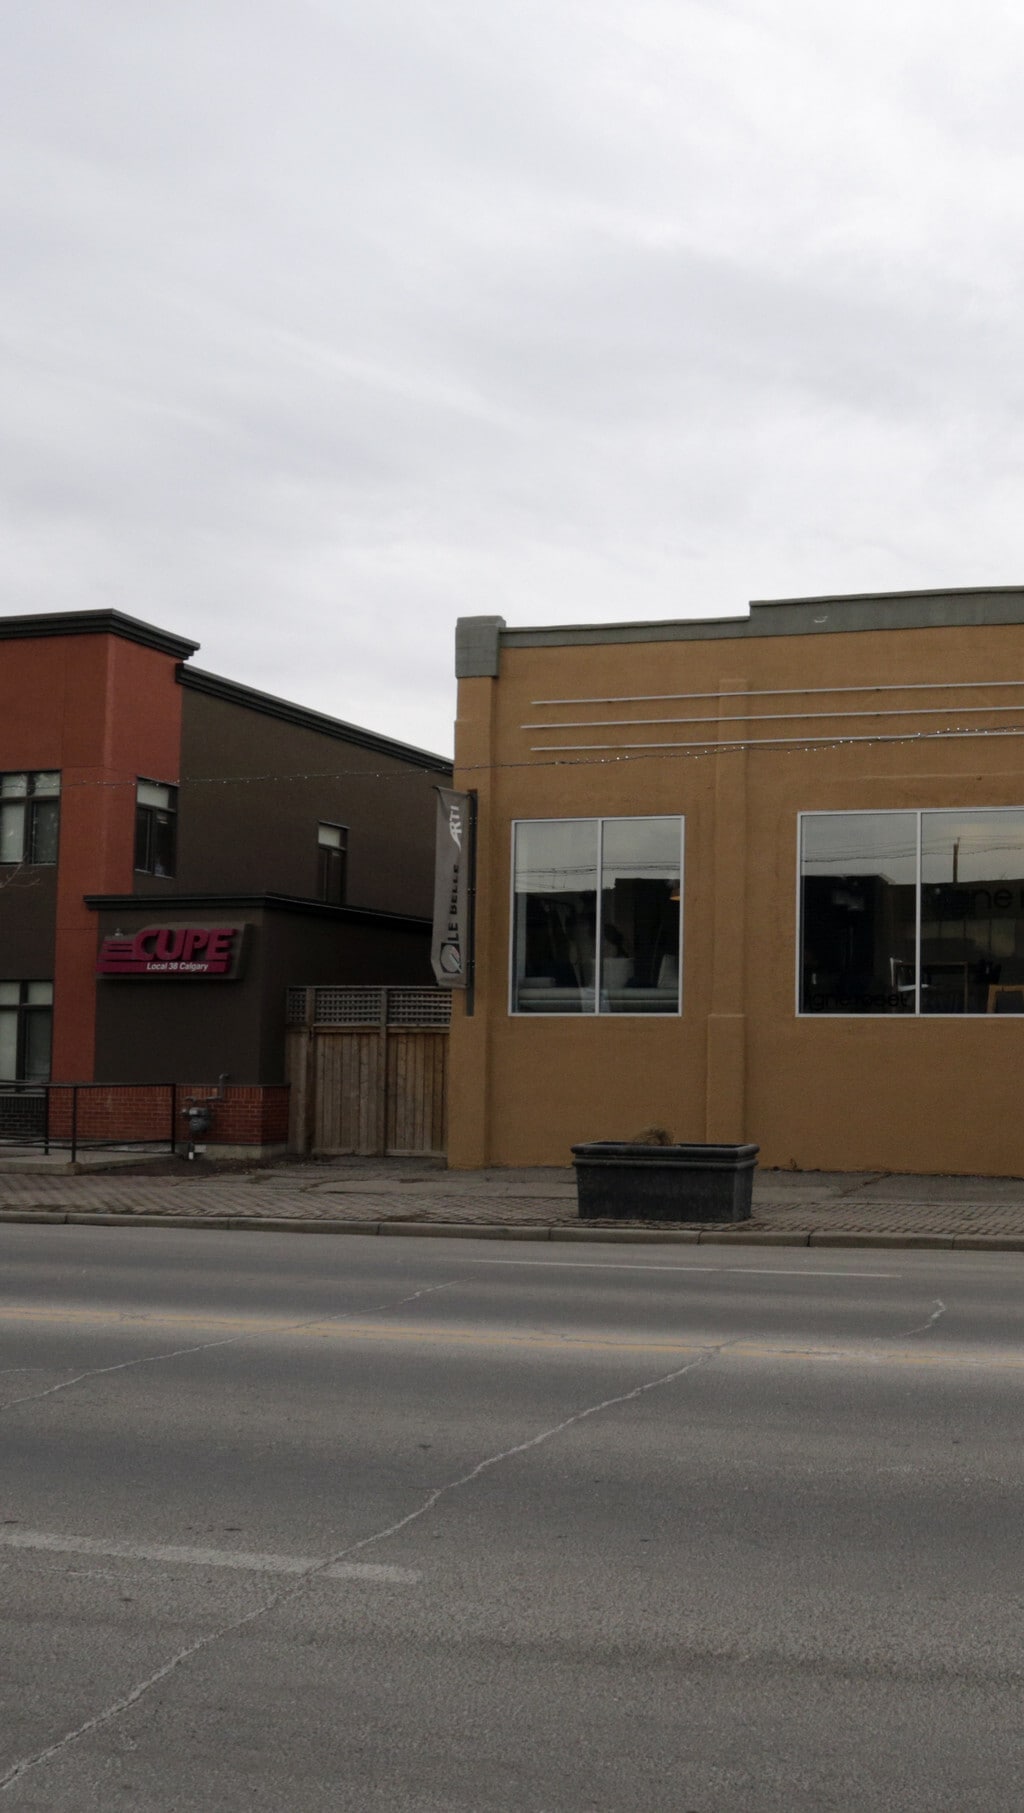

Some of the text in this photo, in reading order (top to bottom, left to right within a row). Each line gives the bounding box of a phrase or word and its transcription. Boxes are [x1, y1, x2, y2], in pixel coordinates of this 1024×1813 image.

[448, 805, 463, 941] LE BELLE ARTI
[131, 928, 235, 961] CUPE
[146, 962, 208, 972] Local 38 Calgary
